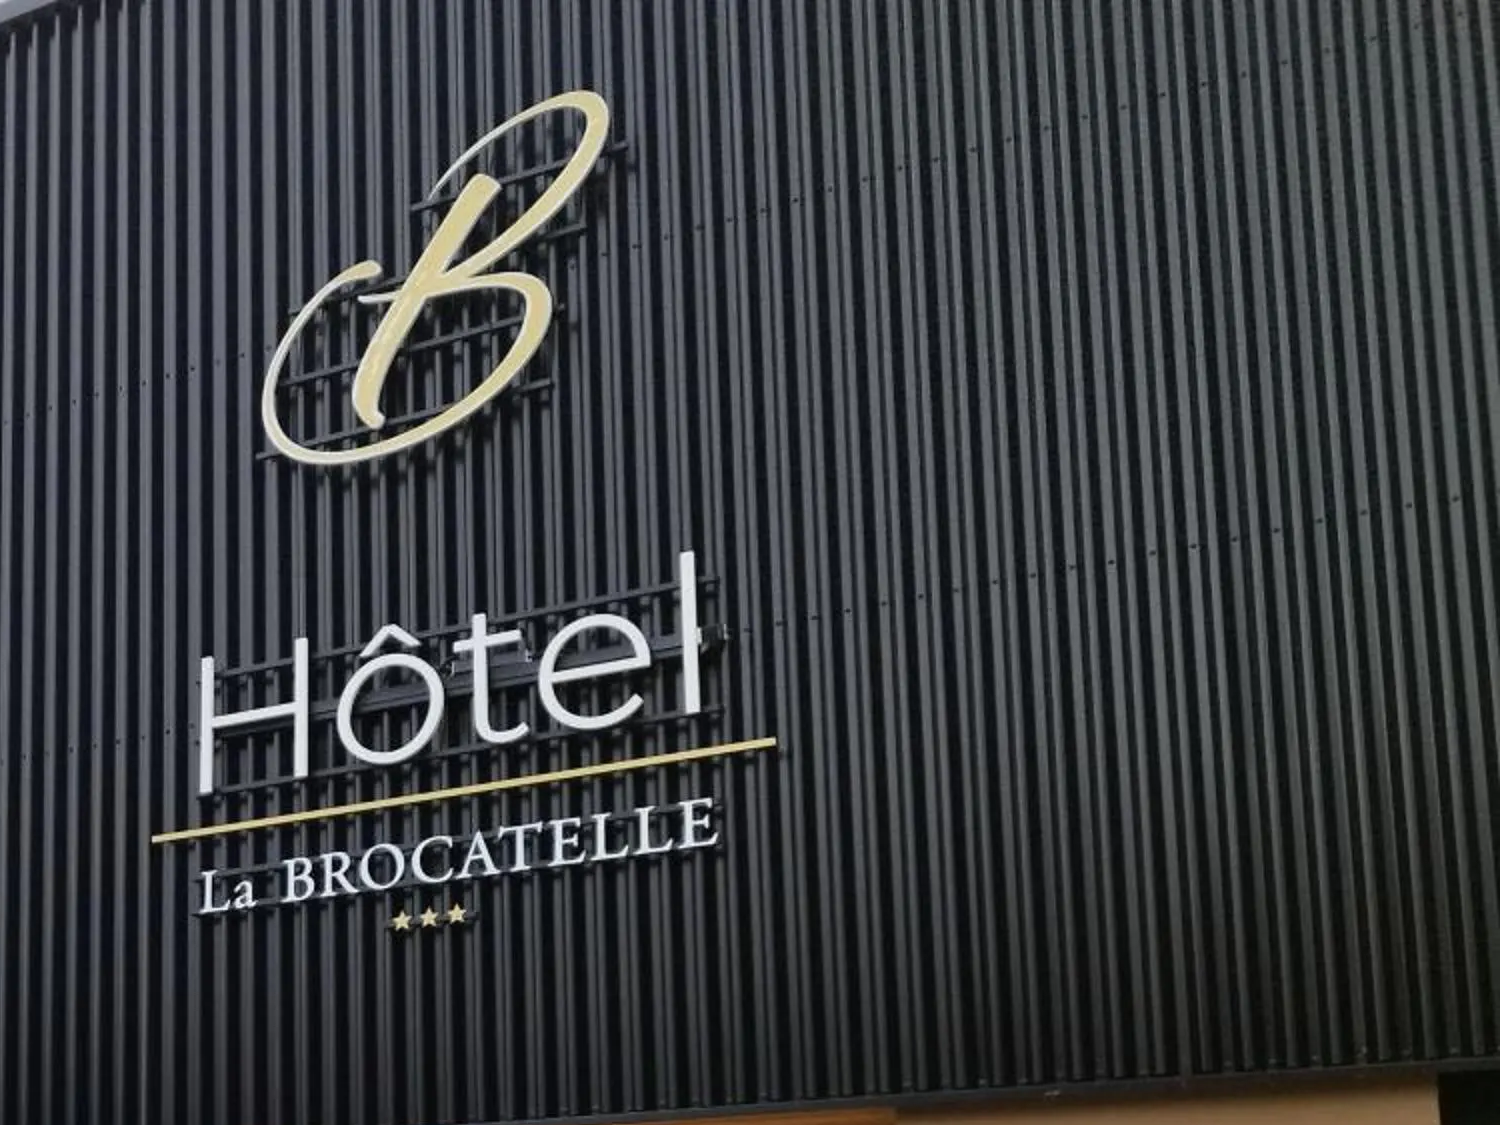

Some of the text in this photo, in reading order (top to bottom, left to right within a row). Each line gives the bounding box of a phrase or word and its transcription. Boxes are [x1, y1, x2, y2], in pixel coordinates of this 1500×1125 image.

[200, 550, 701, 795] Hôtel
[199, 798, 719, 915] La BROCATELLE
